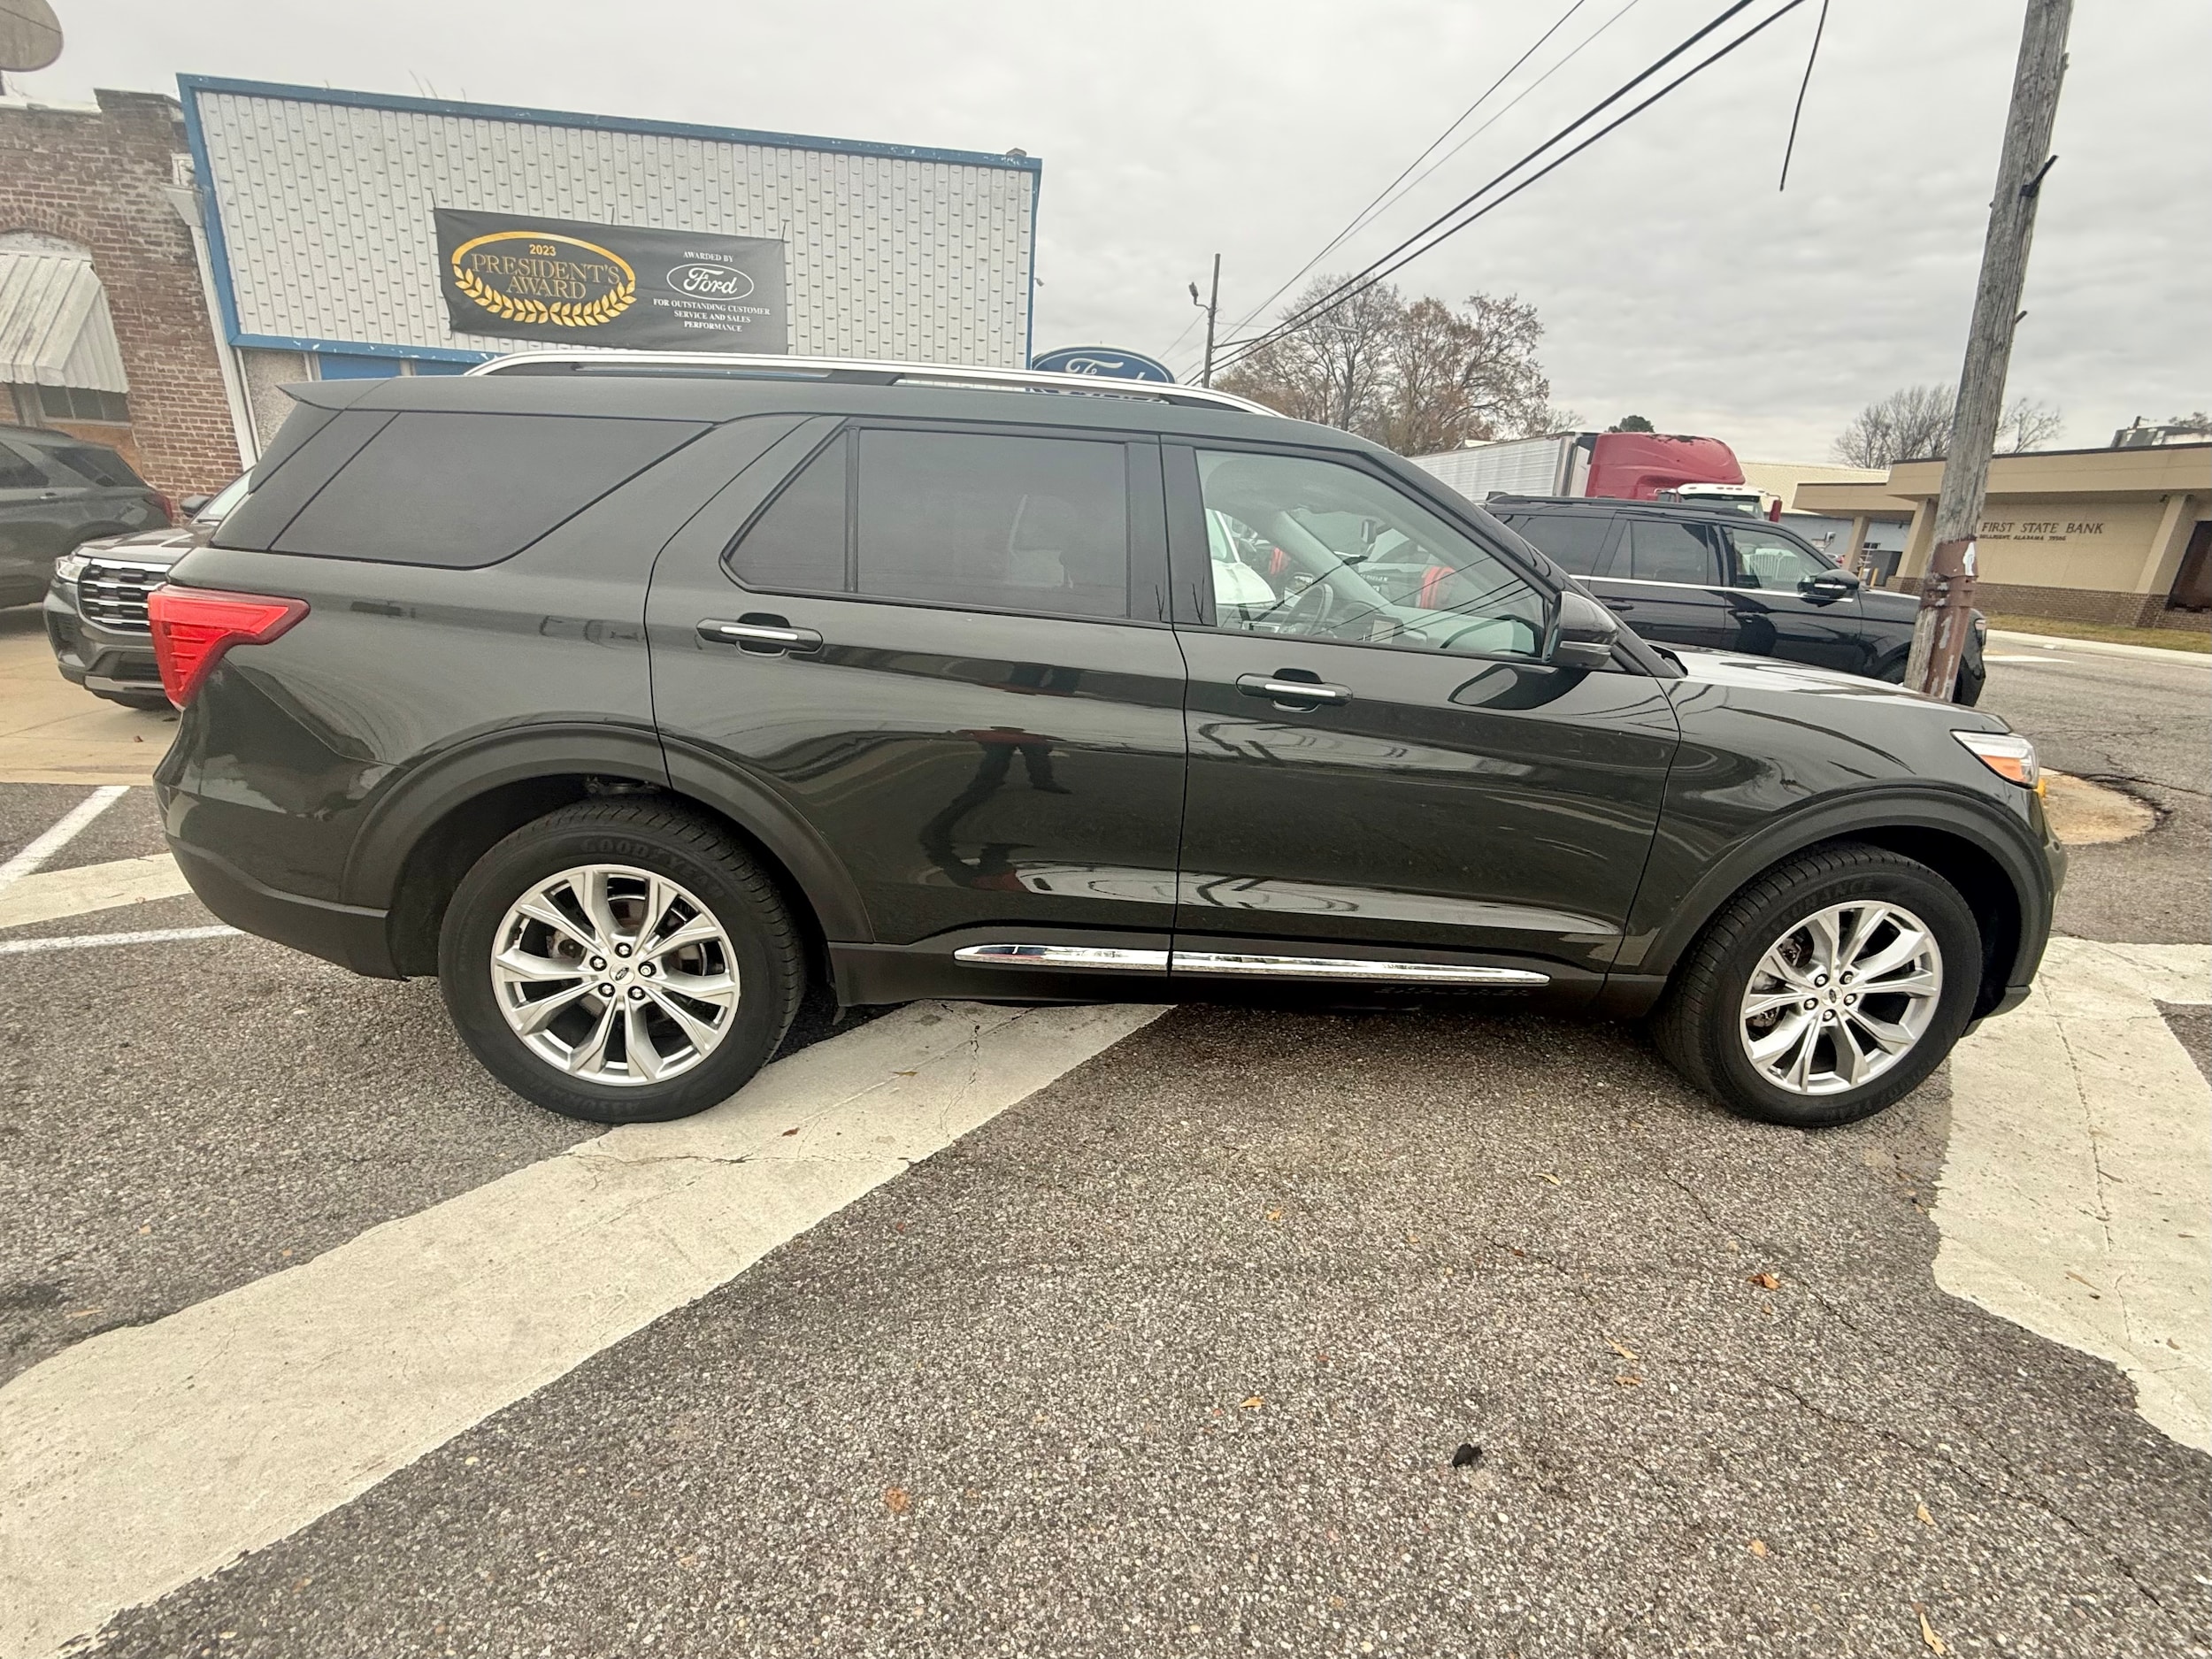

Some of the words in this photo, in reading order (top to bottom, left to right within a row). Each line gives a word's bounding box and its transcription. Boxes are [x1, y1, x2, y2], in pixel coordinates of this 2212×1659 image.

[529, 244, 557, 257] 2023
[683, 251, 721, 261] AWARDED
[471, 254, 620, 284] PRESIDENT'S
[506, 276, 587, 299] AWARD
[683, 267, 738, 294] Ford
[653, 298, 670, 307] FOR
[671, 300, 726, 311] OUTSTANDING
[727, 305, 771, 315] CUSTOMER
[673, 310, 707, 319] SERVICE
[726, 315, 751, 324] SALES
[684, 320, 743, 333] PERFORMANCE
[1982, 522, 2015, 532] FIRST
[2019, 522, 2060, 533] STATE
[2065, 522, 2104, 534] BANK
